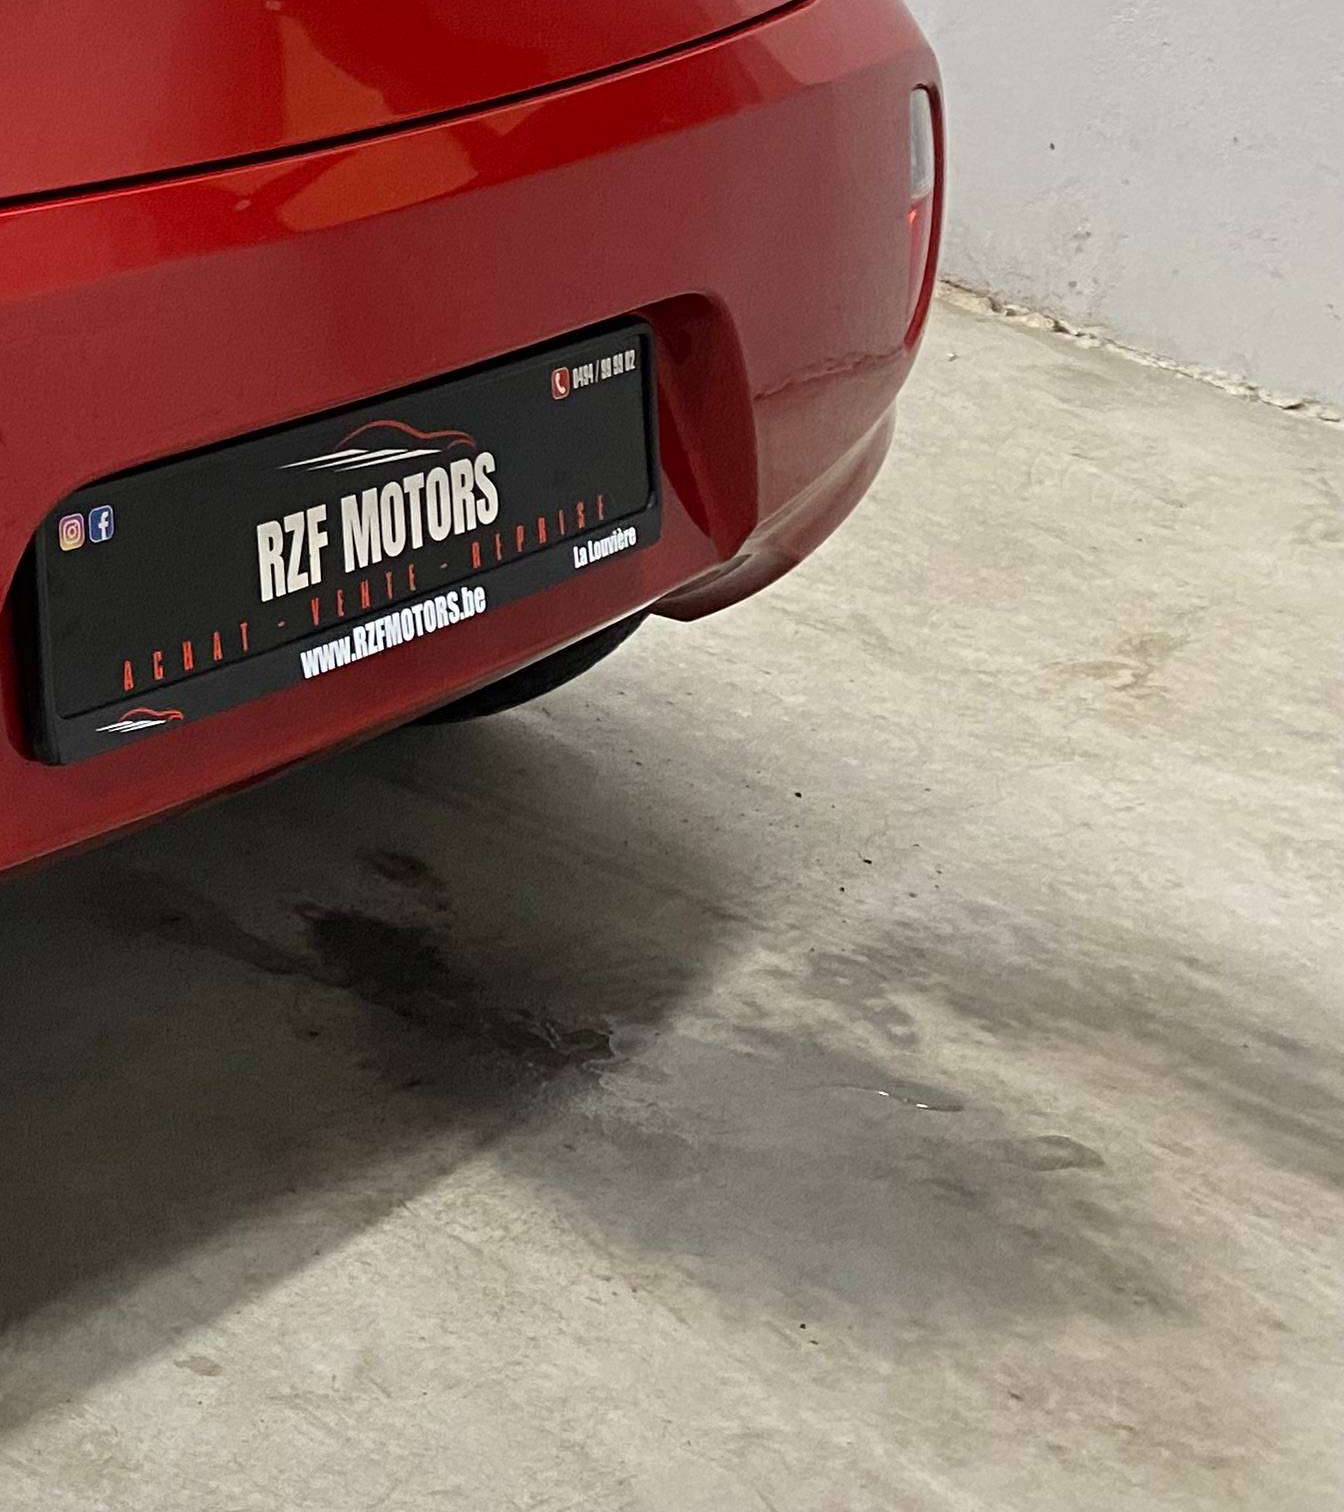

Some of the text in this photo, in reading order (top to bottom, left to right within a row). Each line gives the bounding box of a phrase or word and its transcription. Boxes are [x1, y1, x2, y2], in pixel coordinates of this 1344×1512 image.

[256, 451, 500, 603] RZF MOTORS
[573, 545, 588, 569] La
[123, 620, 249, 692] ACHAT
[299, 586, 487, 679] www.RZFMOTORS.be
